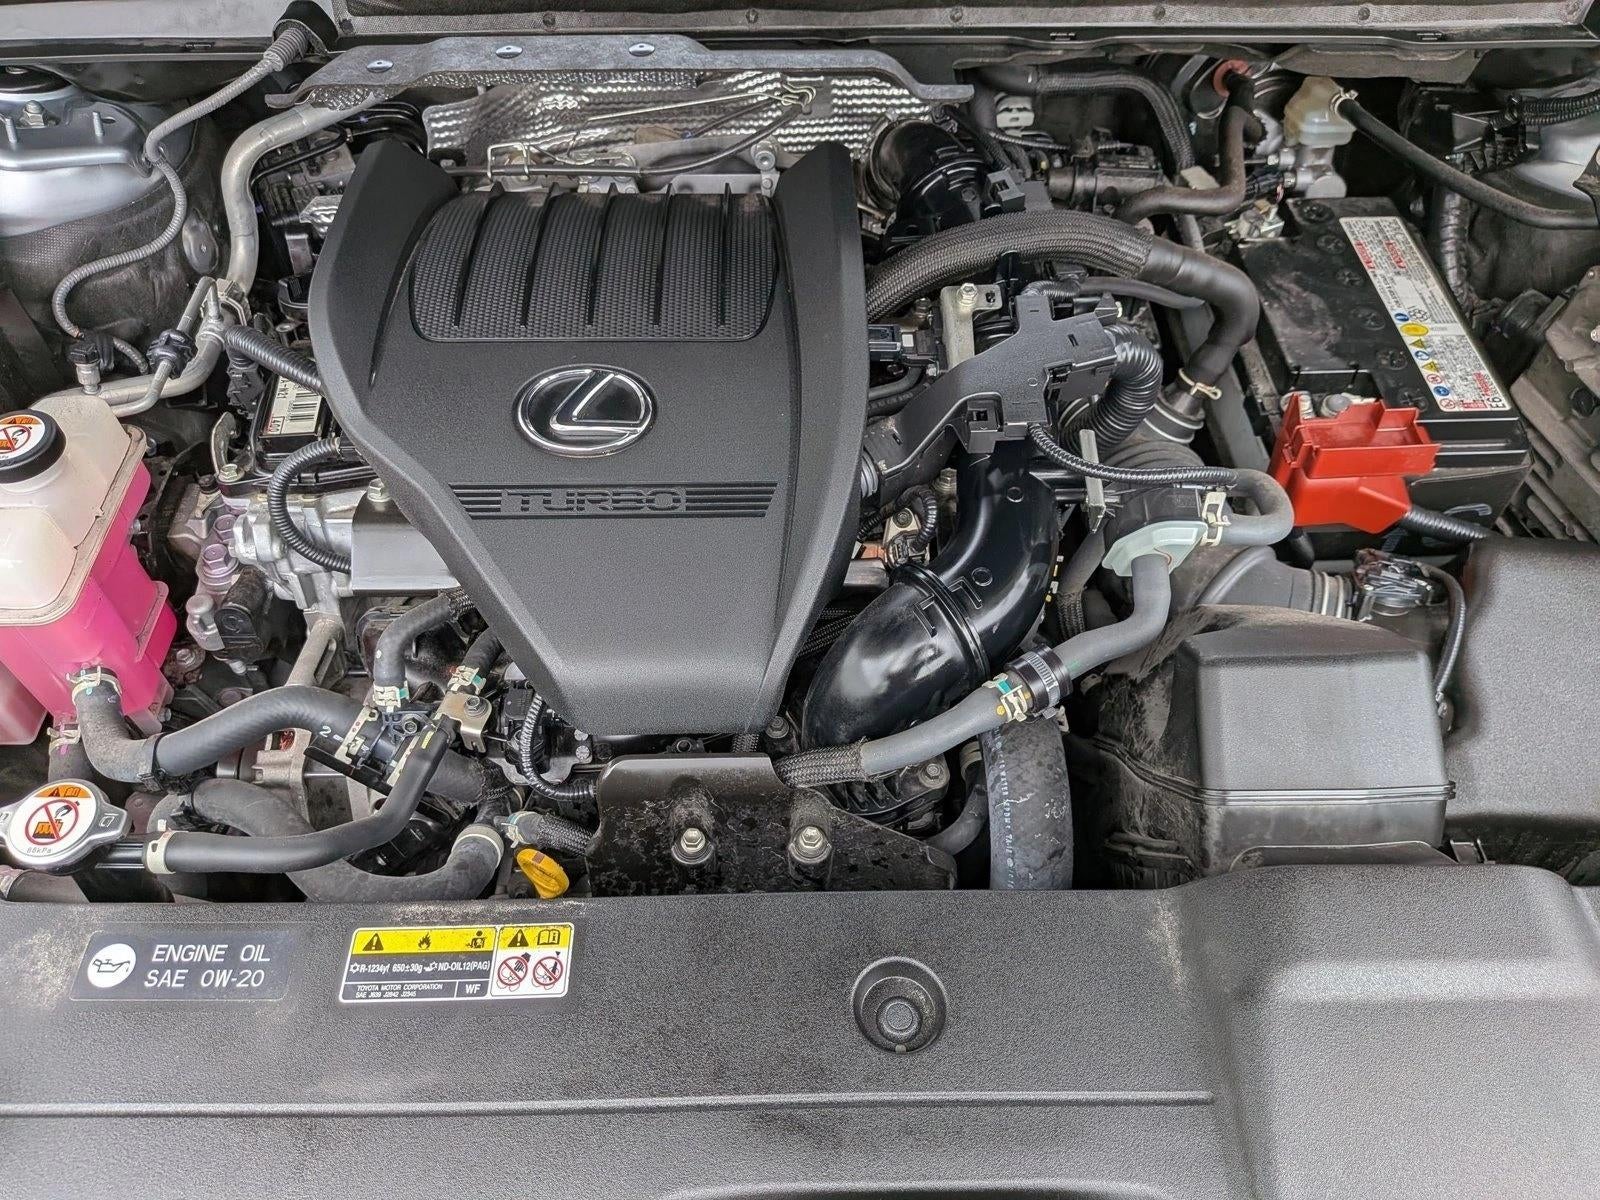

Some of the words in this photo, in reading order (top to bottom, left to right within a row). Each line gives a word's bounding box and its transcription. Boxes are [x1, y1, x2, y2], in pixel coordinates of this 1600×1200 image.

[505, 488, 682, 513] TURBO
[151, 944, 229, 962] ENGINE
[239, 944, 271, 962] OIL
[392, 963, 423, 974] 650±30g
[437, 960, 491, 972] ND-OIL12(PAG)
[144, 969, 189, 987] SAE
[200, 969, 265, 987] 0W-20
[465, 984, 481, 994] WF
